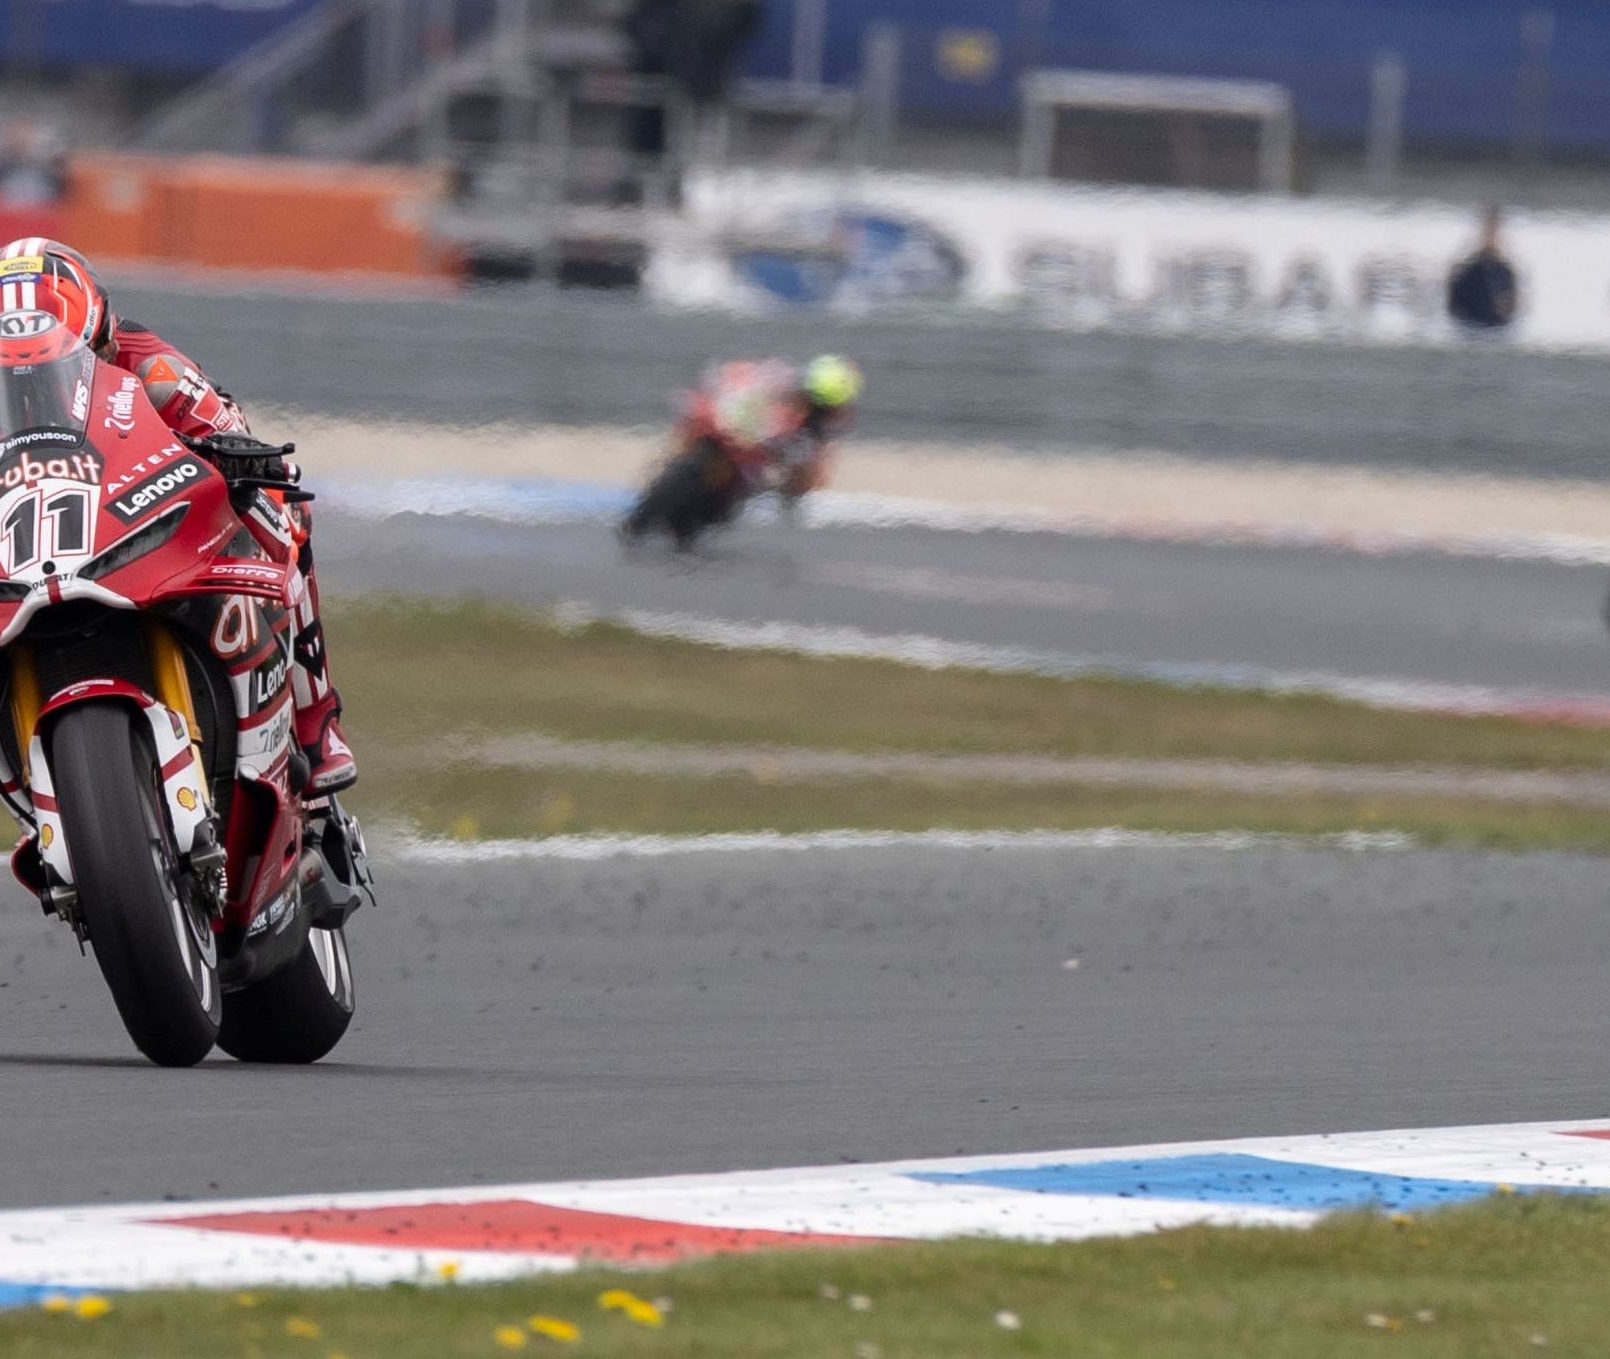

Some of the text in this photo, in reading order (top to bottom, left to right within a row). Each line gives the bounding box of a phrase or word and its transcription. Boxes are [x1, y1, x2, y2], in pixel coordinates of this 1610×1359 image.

[107, 443, 184, 494] ALTEN
[115, 463, 198, 517] Lenovo
[3, 492, 86, 570] 11
[256, 658, 286, 705] Leno
